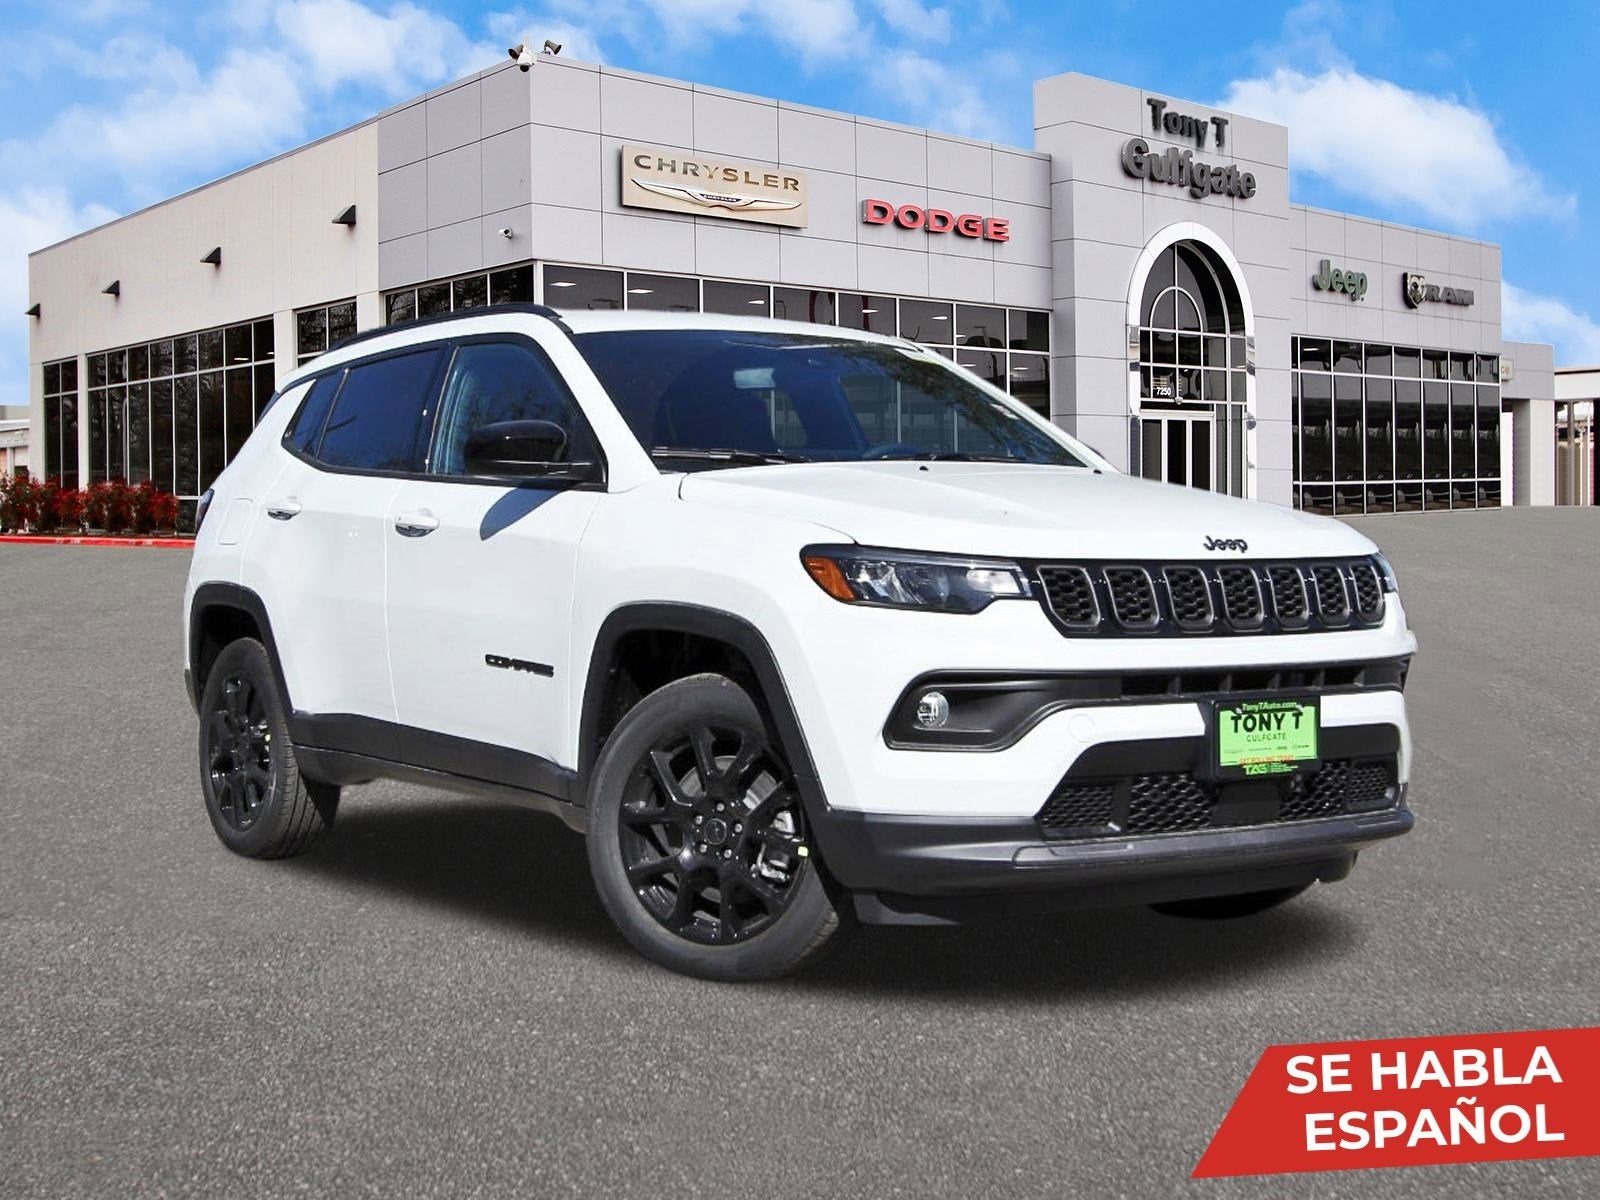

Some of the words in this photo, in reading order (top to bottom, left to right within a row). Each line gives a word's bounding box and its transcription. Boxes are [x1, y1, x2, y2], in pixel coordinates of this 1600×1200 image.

[1147, 98, 1208, 148] Tony
[1210, 116, 1229, 147] T
[632, 154, 800, 193] CHRYSLER
[1121, 138, 1256, 199] Gulfgate
[863, 198, 1010, 243] DODGE
[1312, 259, 1368, 302] Jeep
[1425, 284, 1474, 306] RAM
[1156, 386, 1172, 396] 7250
[1203, 535, 1248, 553] Jeep
[1230, 713, 1286, 733] TONY
[1292, 711, 1303, 729] T
